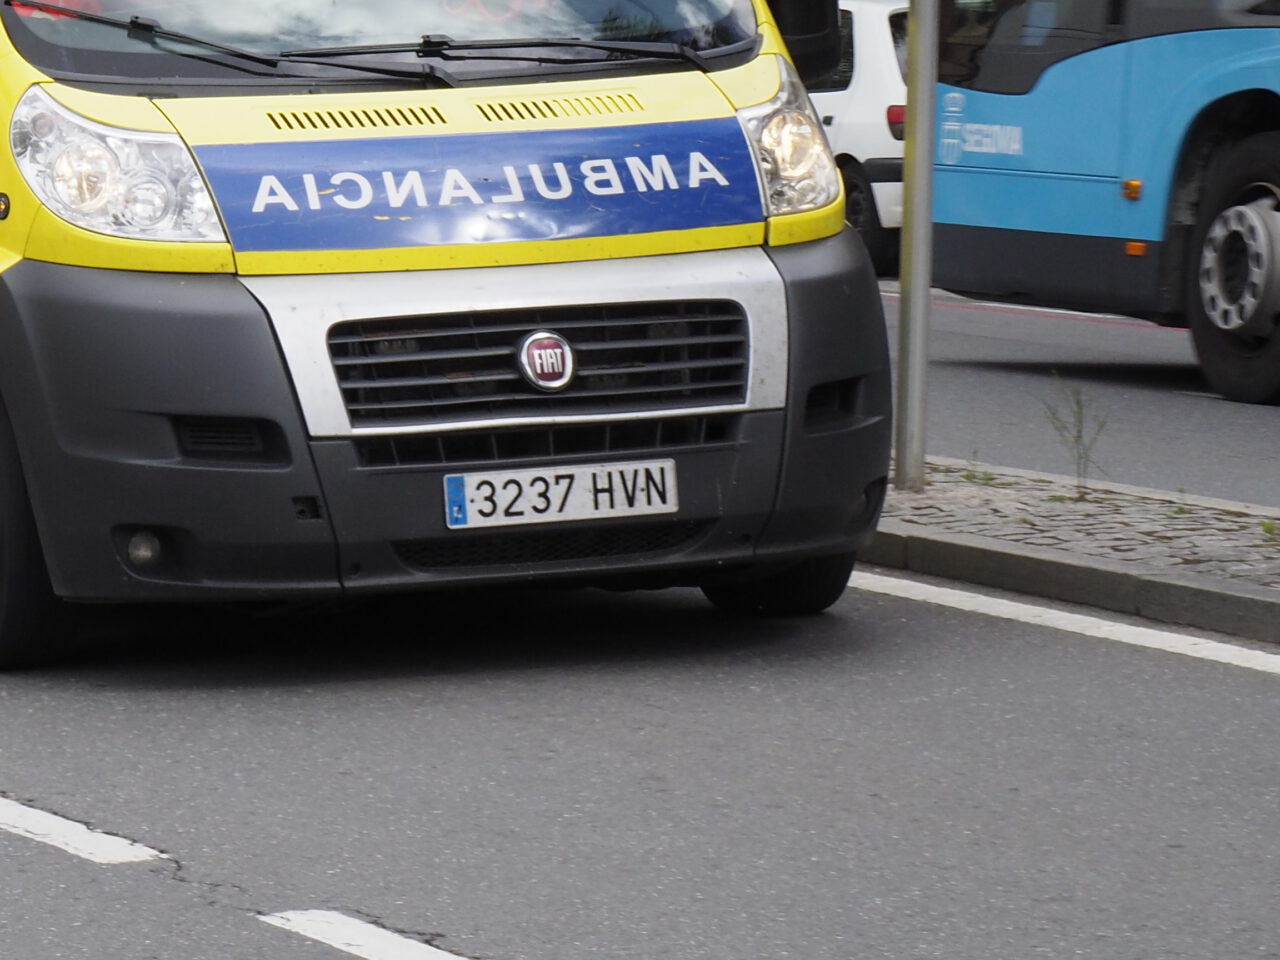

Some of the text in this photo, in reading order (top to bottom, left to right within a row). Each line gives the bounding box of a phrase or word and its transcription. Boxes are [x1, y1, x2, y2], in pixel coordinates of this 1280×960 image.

[533, 348, 563, 374] FIAT
[475, 466, 669, 519] 3237 HVN
